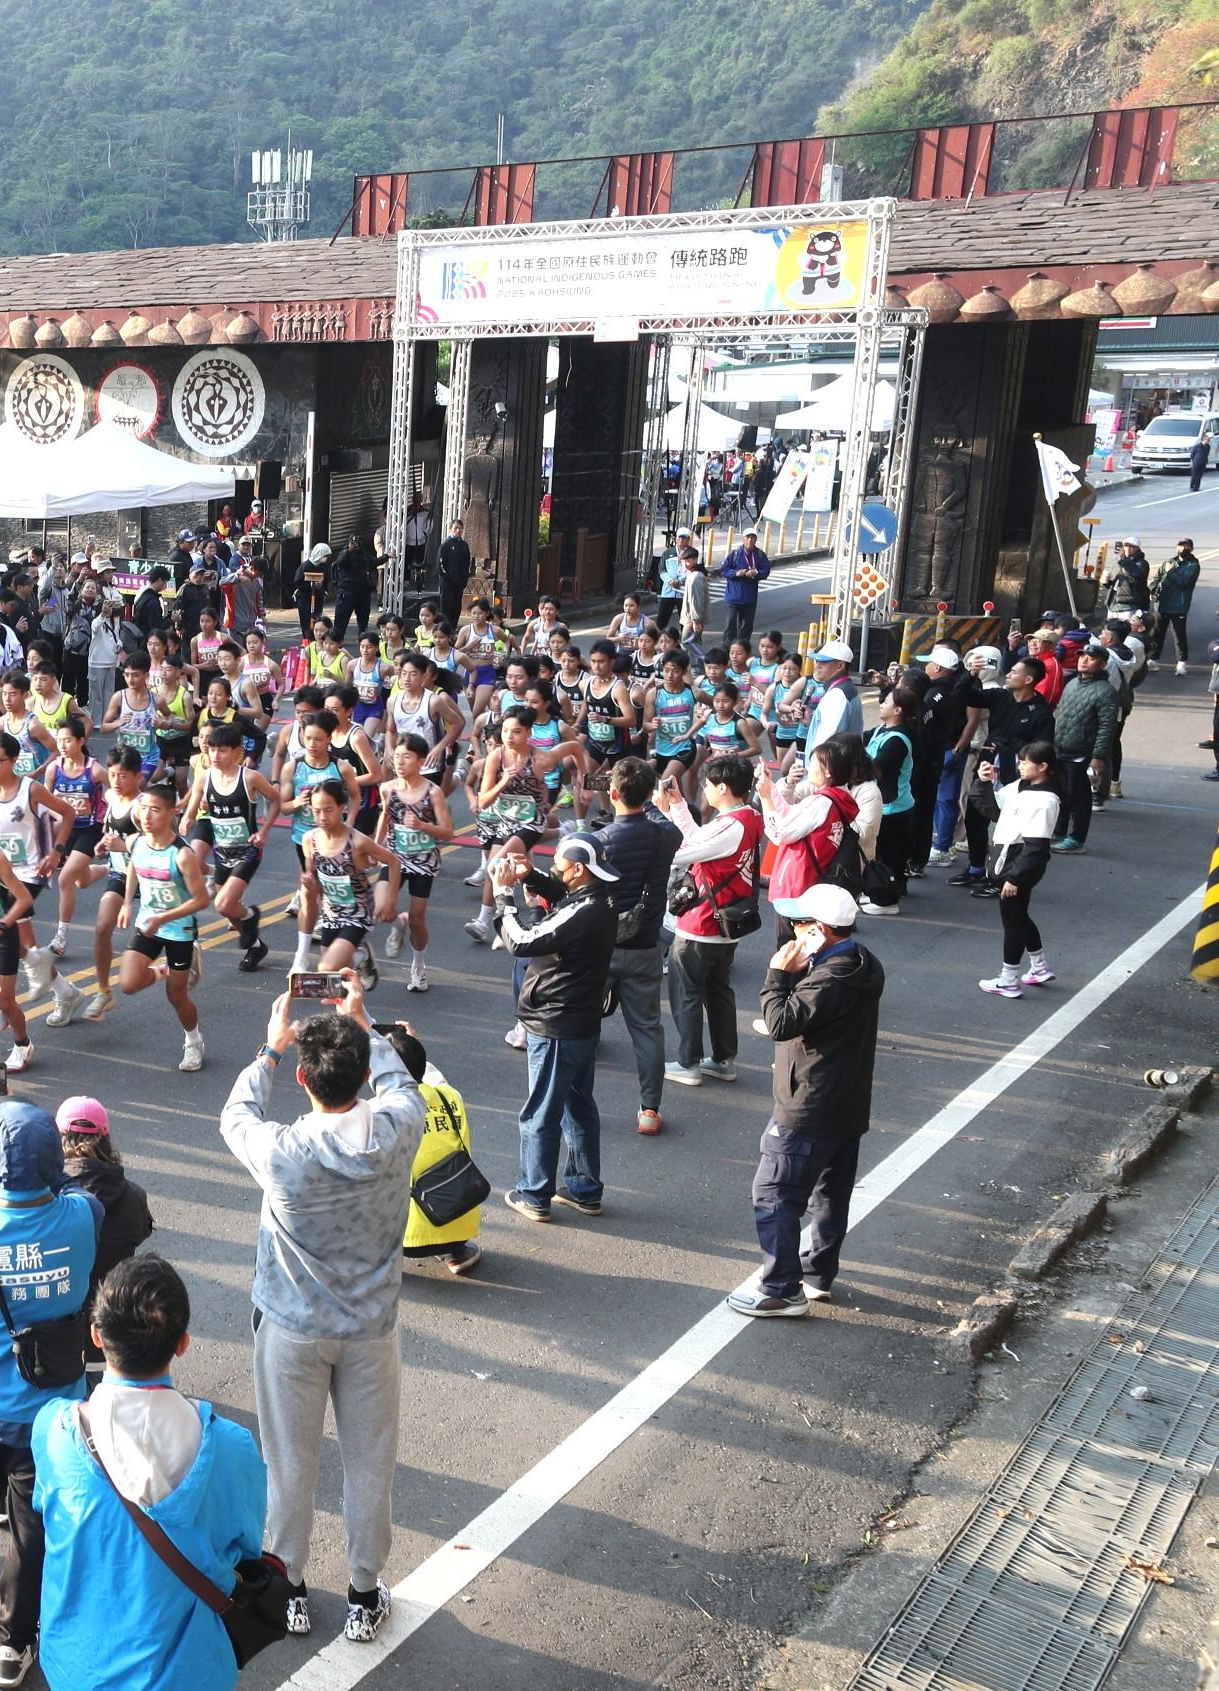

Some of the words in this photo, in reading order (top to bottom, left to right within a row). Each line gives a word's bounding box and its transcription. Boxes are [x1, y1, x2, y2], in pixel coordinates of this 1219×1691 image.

[670, 247, 748, 269] 傳統路跑
[497, 274, 549, 285] NATIONAL
[550, 269, 616, 282] INDIGENOUS
[618, 269, 657, 280] GAMES
[663, 722, 687, 733] 316
[216, 824, 244, 839] 322
[399, 831, 430, 846] 306
